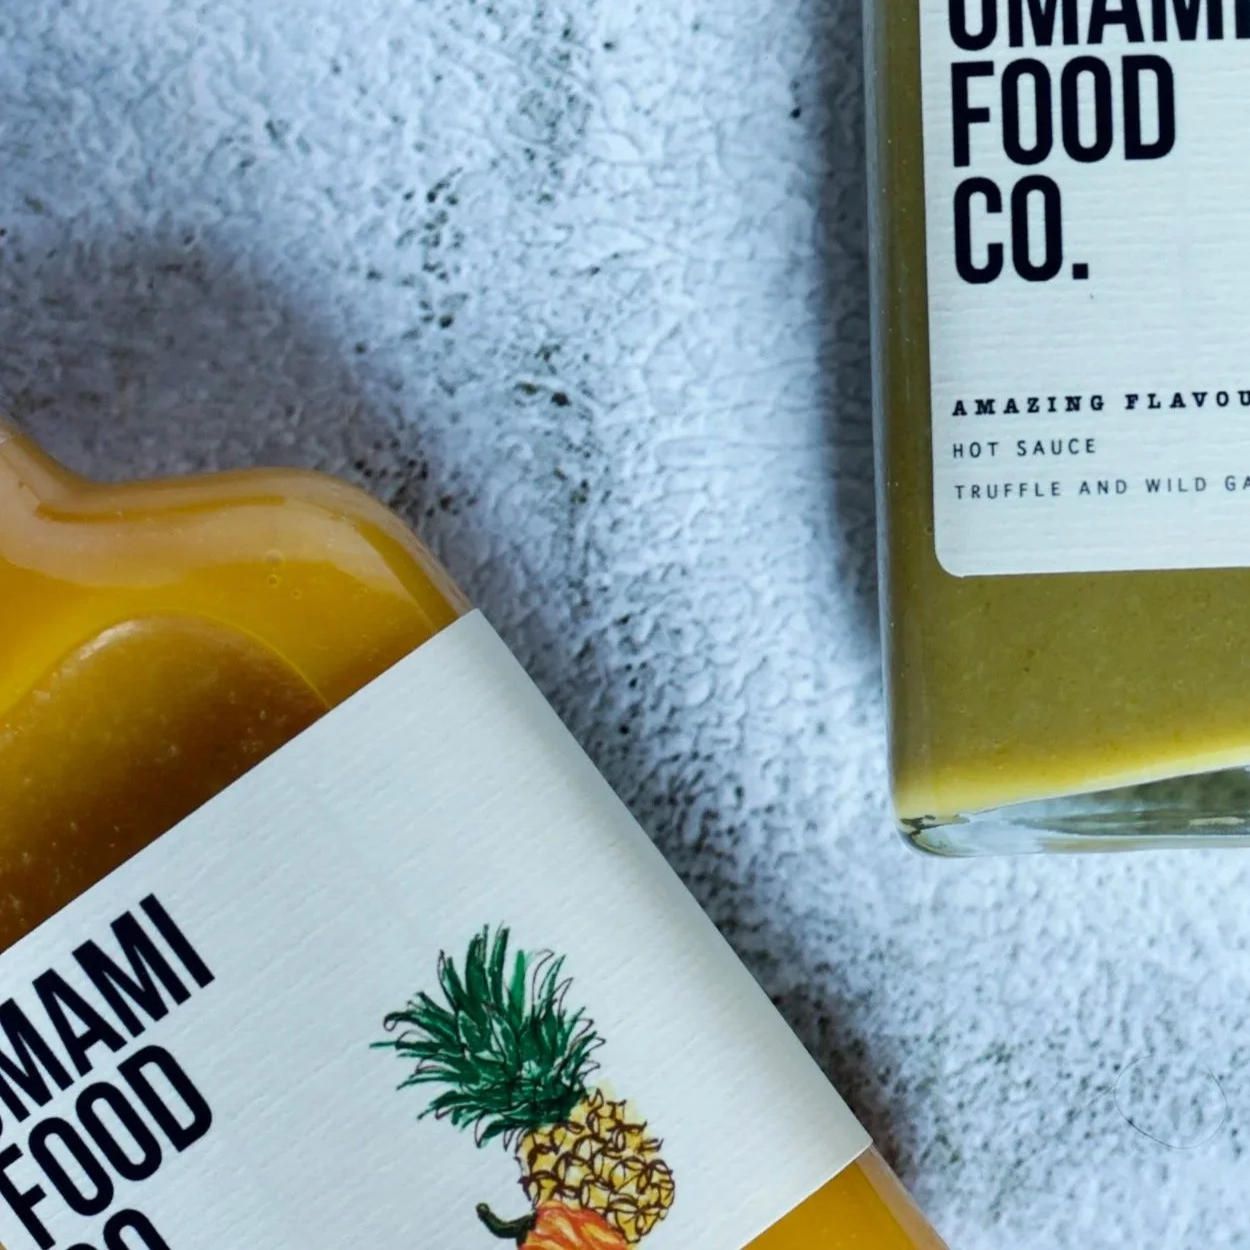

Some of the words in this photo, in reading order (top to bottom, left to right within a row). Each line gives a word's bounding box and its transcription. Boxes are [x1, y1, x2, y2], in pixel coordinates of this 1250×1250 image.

[950, 54, 1176, 168] FOOD
[953, 174, 1089, 285] CO.
[951, 395, 1105, 417] AMAZING
[952, 441, 999, 459] HOT
[1016, 438, 1096, 457] SAUCE
[954, 481, 1061, 500] TRUFFLE
[1079, 479, 1128, 496] AND
[1145, 476, 1208, 494] WILD
[0, 893, 216, 1123] MAMI
[0, 1044, 213, 1250] FOOD
